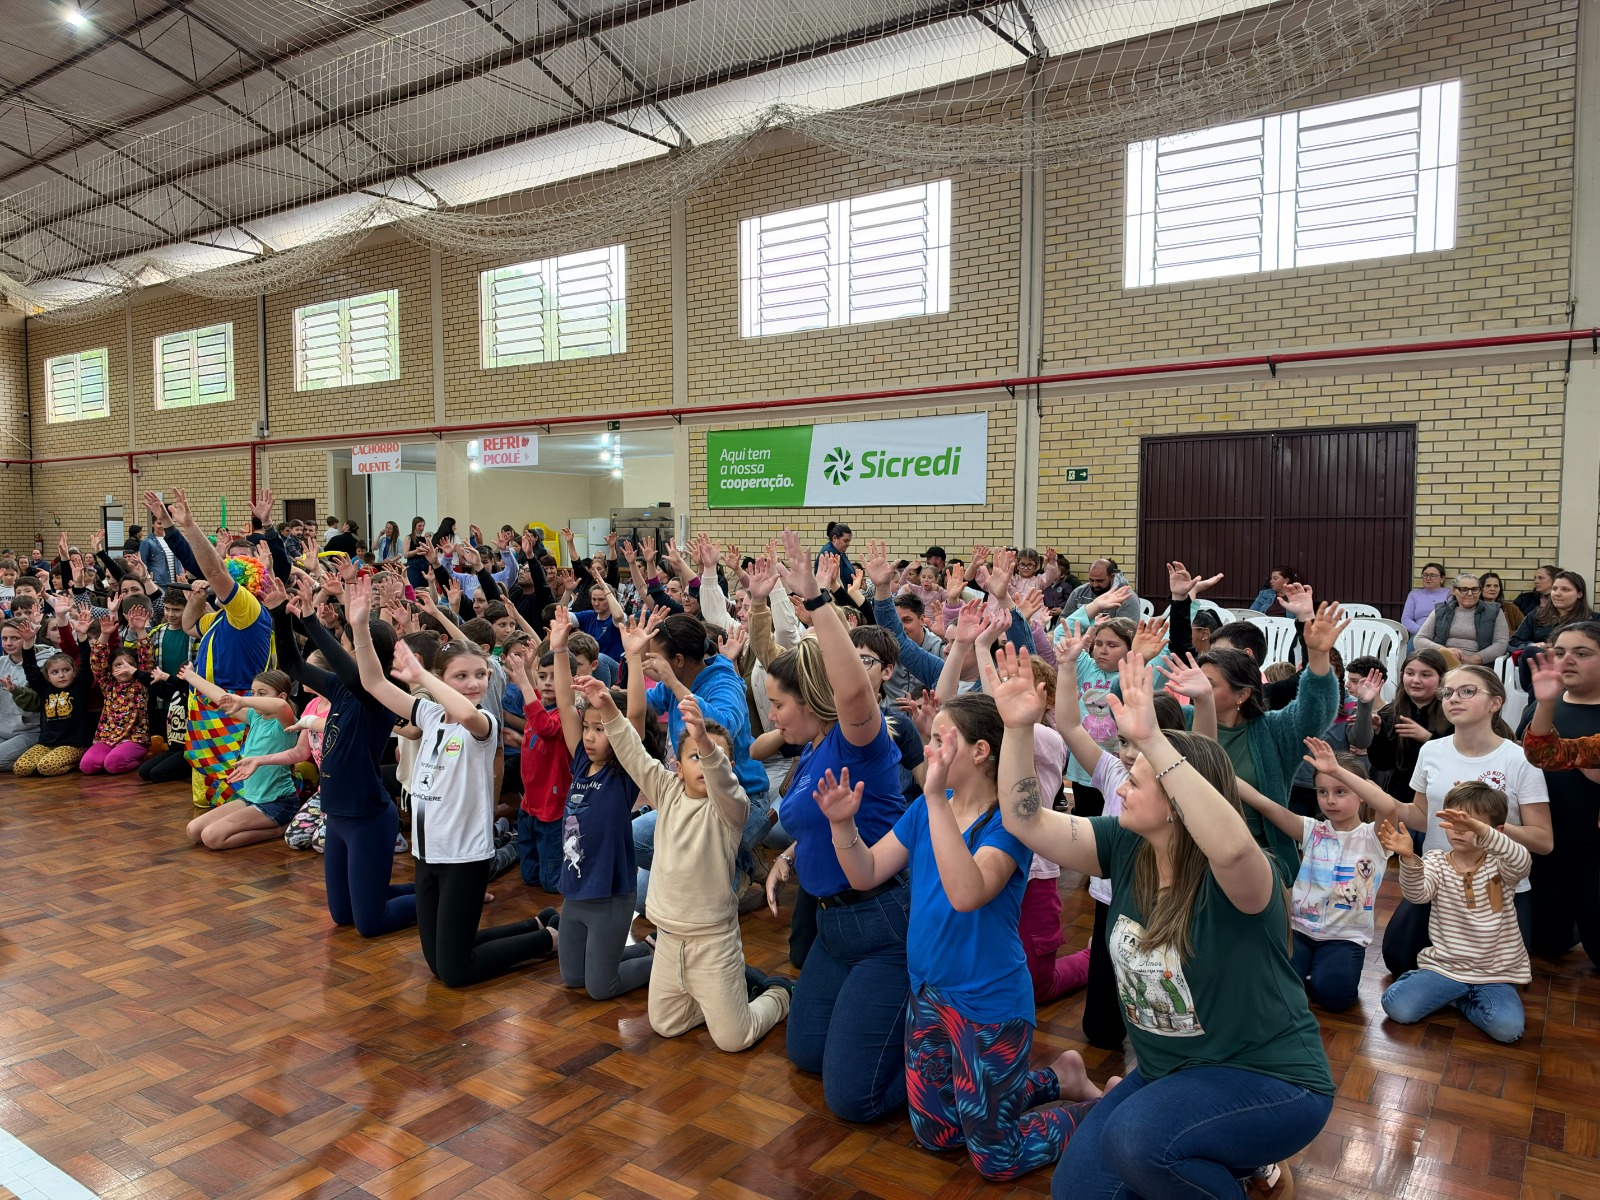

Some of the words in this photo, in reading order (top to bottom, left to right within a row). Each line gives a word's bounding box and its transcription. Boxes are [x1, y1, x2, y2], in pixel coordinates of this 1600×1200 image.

[352, 442, 399, 455] CACHORRO
[483, 436, 520, 451] REFRI
[483, 449, 521, 465] PICOLÉ
[720, 447, 746, 464] Aqui
[748, 448, 771, 460] tem
[860, 446, 961, 479] Sicredi
[358, 461, 391, 473] QUENTE
[720, 465, 728, 475] a
[730, 464, 765, 475] nossa
[720, 474, 795, 492] cooperação.
